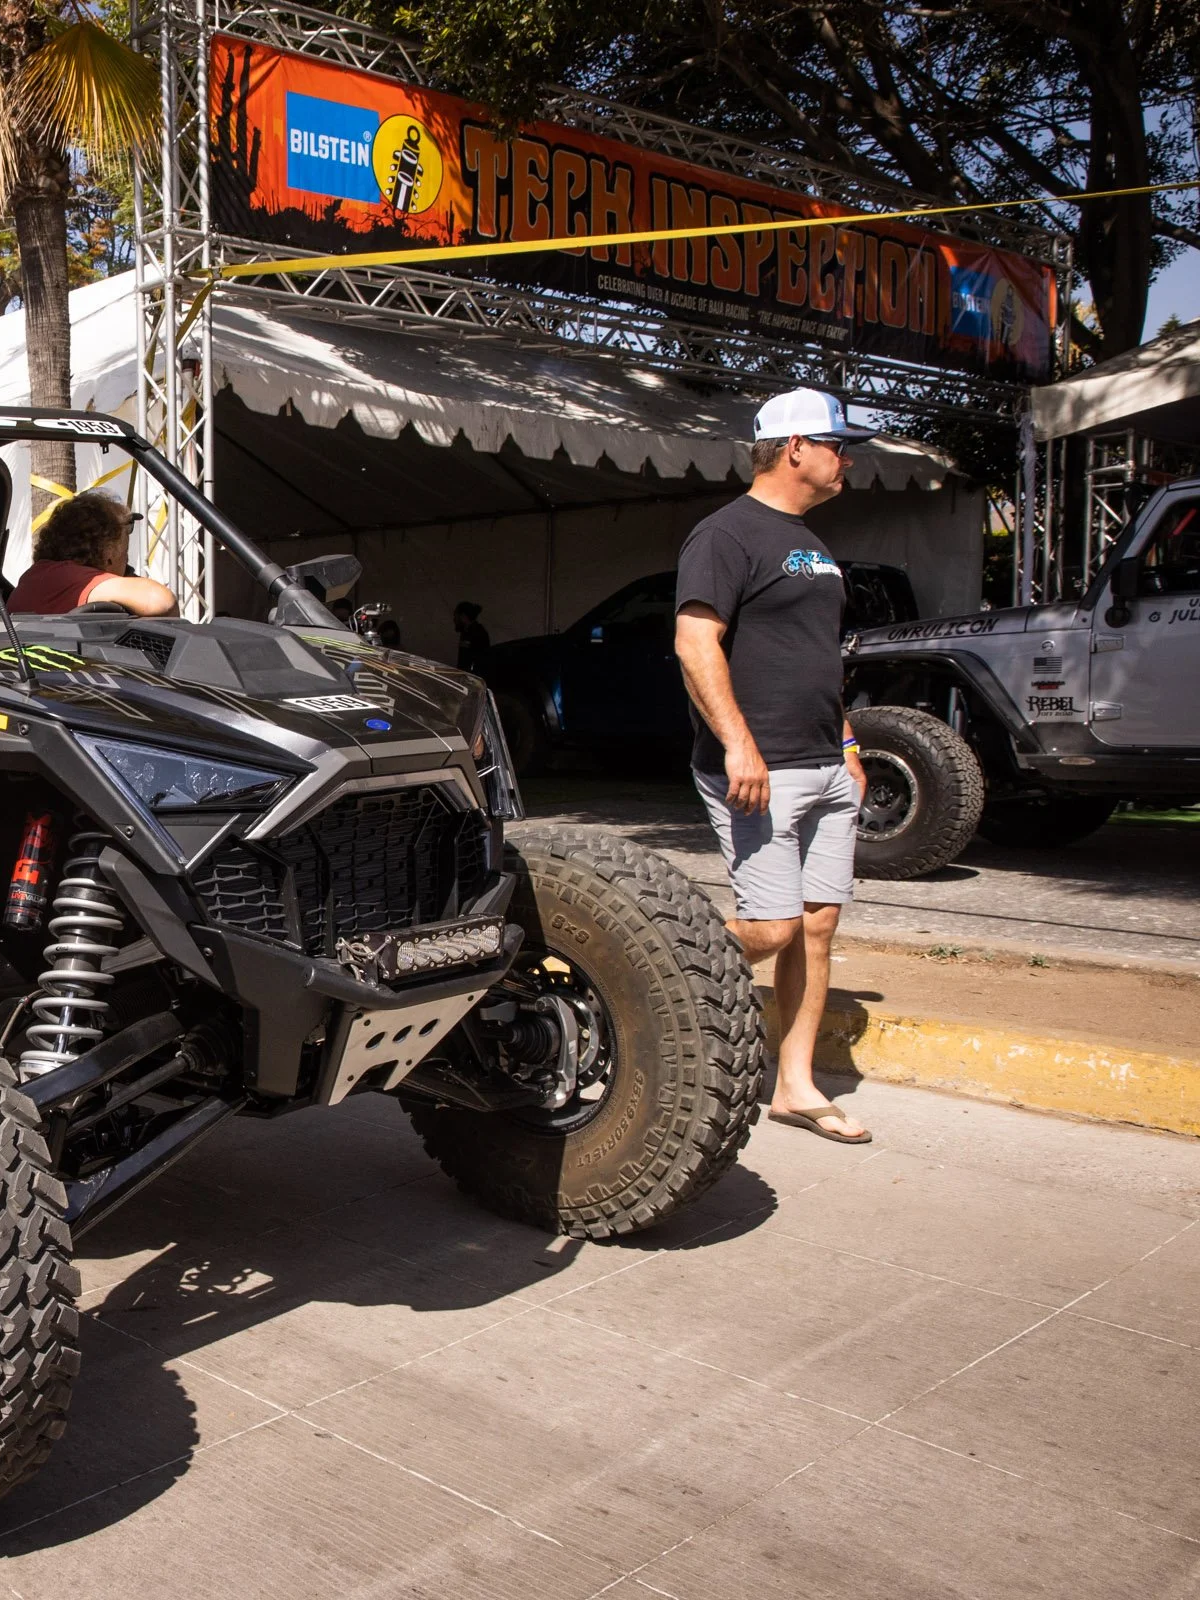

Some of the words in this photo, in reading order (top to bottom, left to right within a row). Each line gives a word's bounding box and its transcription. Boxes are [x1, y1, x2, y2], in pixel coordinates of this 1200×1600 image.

[290, 128, 370, 167] BILSTEIN
[464, 124, 632, 266] TECH
[651, 177, 937, 336] INSPECTION
[598, 274, 646, 297] CELEBRATING
[647, 285, 664, 301] OVER
[671, 292, 697, 311] DECADE
[698, 299, 708, 312] OF
[709, 301, 724, 316] BAJA
[725, 303, 749, 321] RACING
[772, 313, 801, 331] HAPPIEST
[801, 320, 817, 335] RACE
[67, 420, 119, 434] 1959
[1189, 598, 1200, 608] U
[1168, 609, 1200, 625] JUL
[296, 697, 369, 710] 1959
[1026, 696, 1085, 717] REBEL
